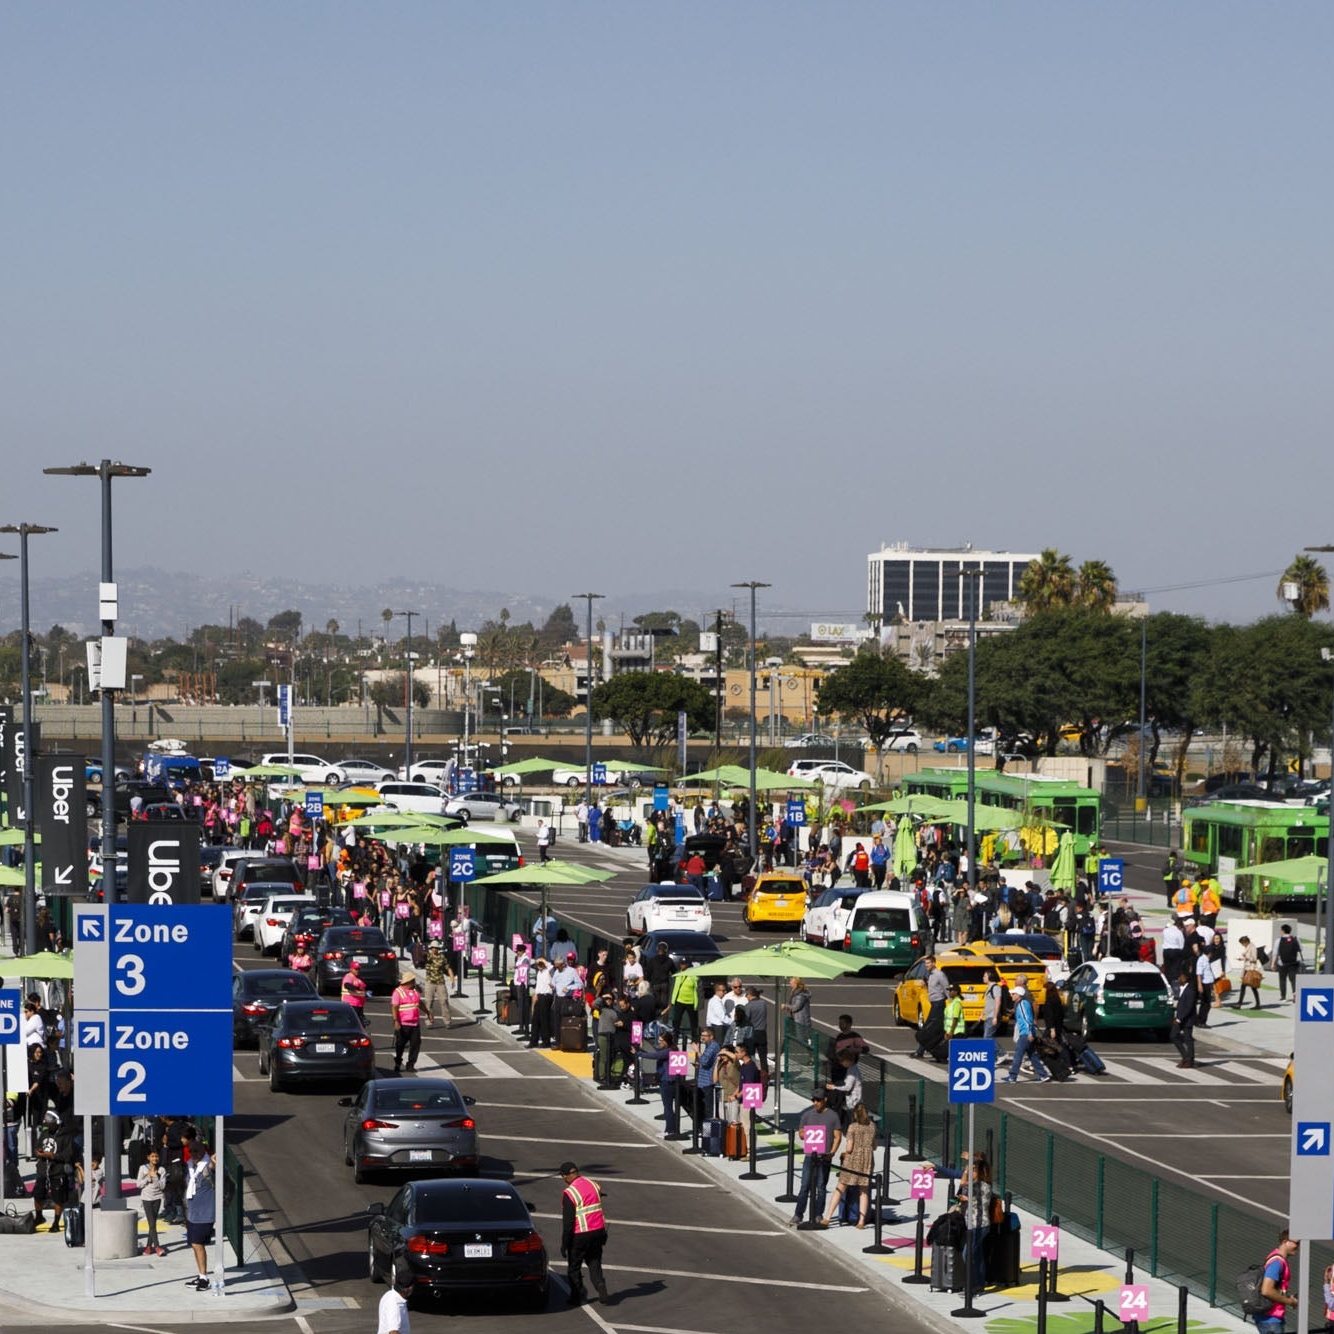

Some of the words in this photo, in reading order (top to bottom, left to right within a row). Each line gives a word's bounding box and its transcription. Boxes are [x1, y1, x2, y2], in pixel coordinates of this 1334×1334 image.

[828, 625, 845, 636] LAX
[217, 765, 228, 773] 2A
[594, 772, 605, 782] 1A
[52, 766, 74, 824] Uber
[307, 803, 322, 813] 2B
[789, 811, 804, 822] 1B
[148, 840, 180, 905] Ube
[452, 862, 474, 876] 2C
[1101, 873, 1122, 886] 1C
[397, 905, 409, 914] 13
[115, 919, 189, 943] Zone
[430, 923, 442, 932] 14
[454, 937, 465, 945] 15
[473, 950, 485, 959] 16
[115, 954, 146, 996] 3
[517, 967, 527, 977] 17
[632, 1026, 642, 1036] 19
[115, 1026, 190, 1050] Zone
[669, 1055, 687, 1067] 20
[957, 1052, 988, 1062] ZONE
[116, 1061, 147, 1102] 2
[953, 1067, 992, 1091] 2D
[744, 1087, 760, 1100] 21
[805, 1130, 824, 1144] 22
[913, 1174, 933, 1189] 23
[1033, 1231, 1058, 1248] 24
[1121, 1291, 1147, 1309] 24
